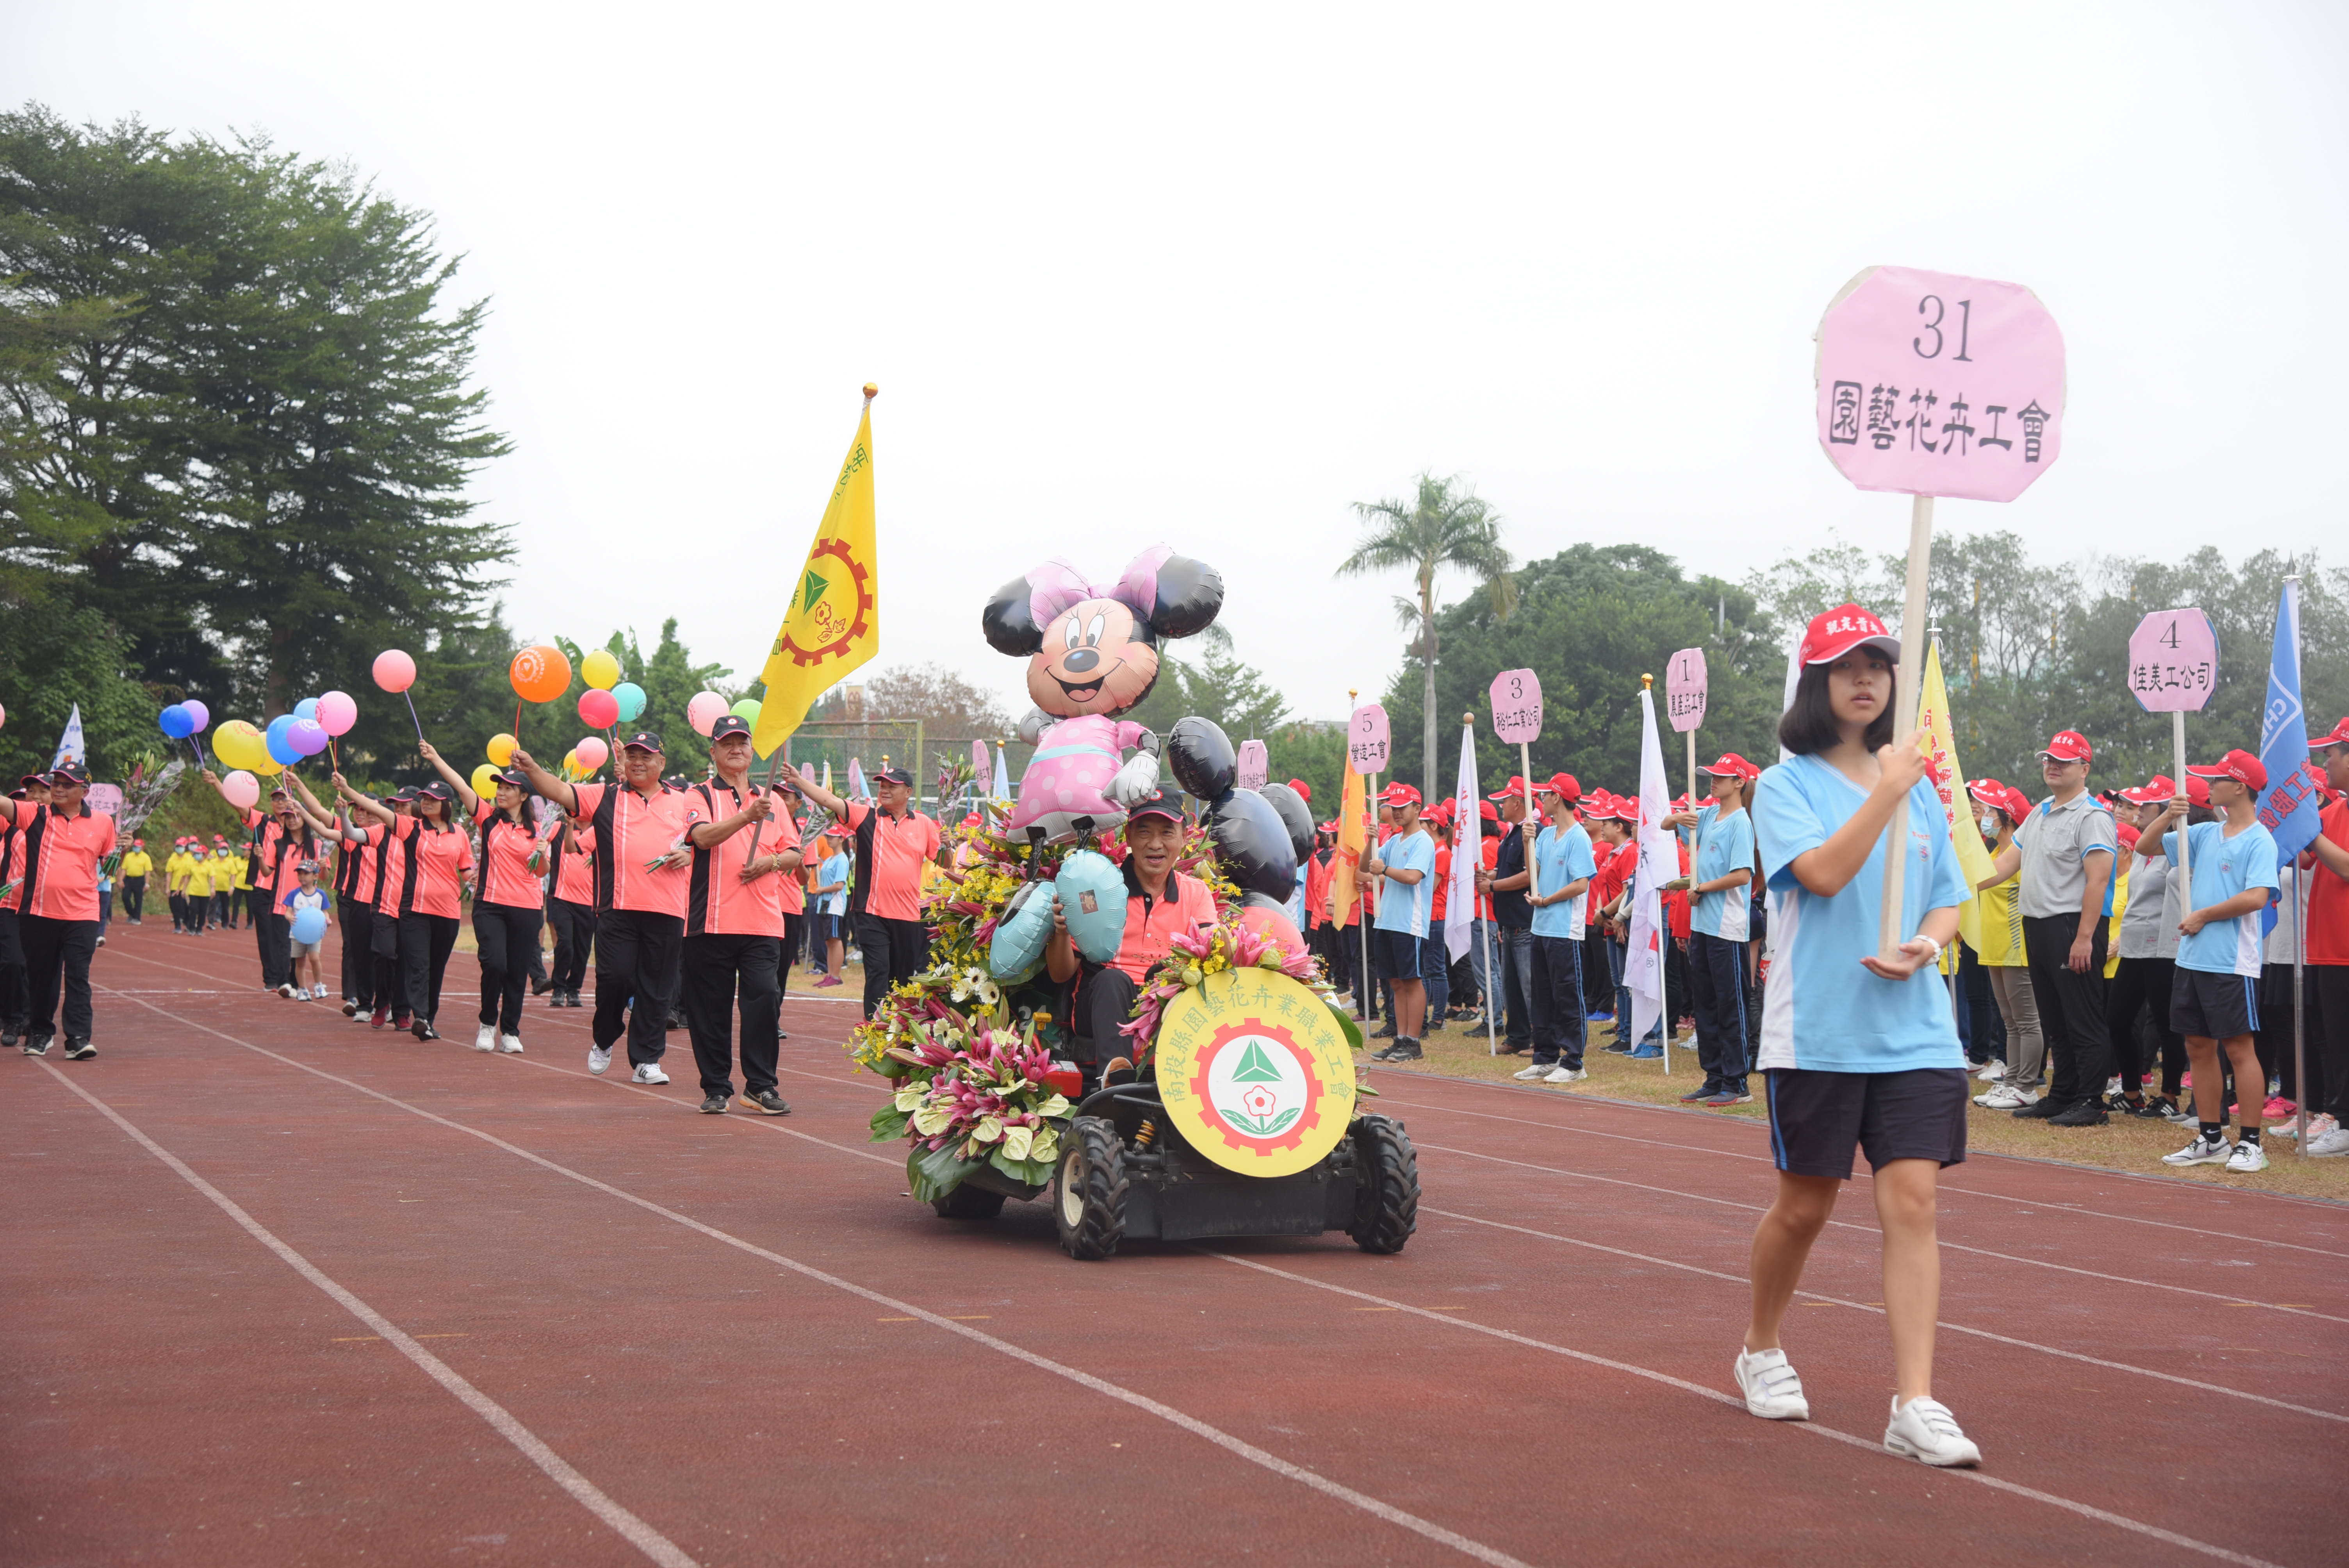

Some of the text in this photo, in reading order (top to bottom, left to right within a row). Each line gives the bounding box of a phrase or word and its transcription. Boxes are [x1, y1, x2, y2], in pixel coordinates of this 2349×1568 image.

[1913, 295, 1973, 362] 31
[1830, 380, 2051, 463] 園藝花卉工會
[2159, 620, 2182, 649] 4
[1682, 658, 1690, 682] 1
[2133, 661, 2210, 692] 佳美工公司
[1511, 677, 1522, 699] 3
[1362, 713, 1372, 732] 5
[1496, 706, 1539, 732] 裕仁工業公司
[1247, 747, 1255, 765] 7
[1351, 739, 1386, 762] 營造工會
[92, 787, 106, 797] 32
[1163, 984, 1352, 1103] 南投縣園藝花卉業職業工會
